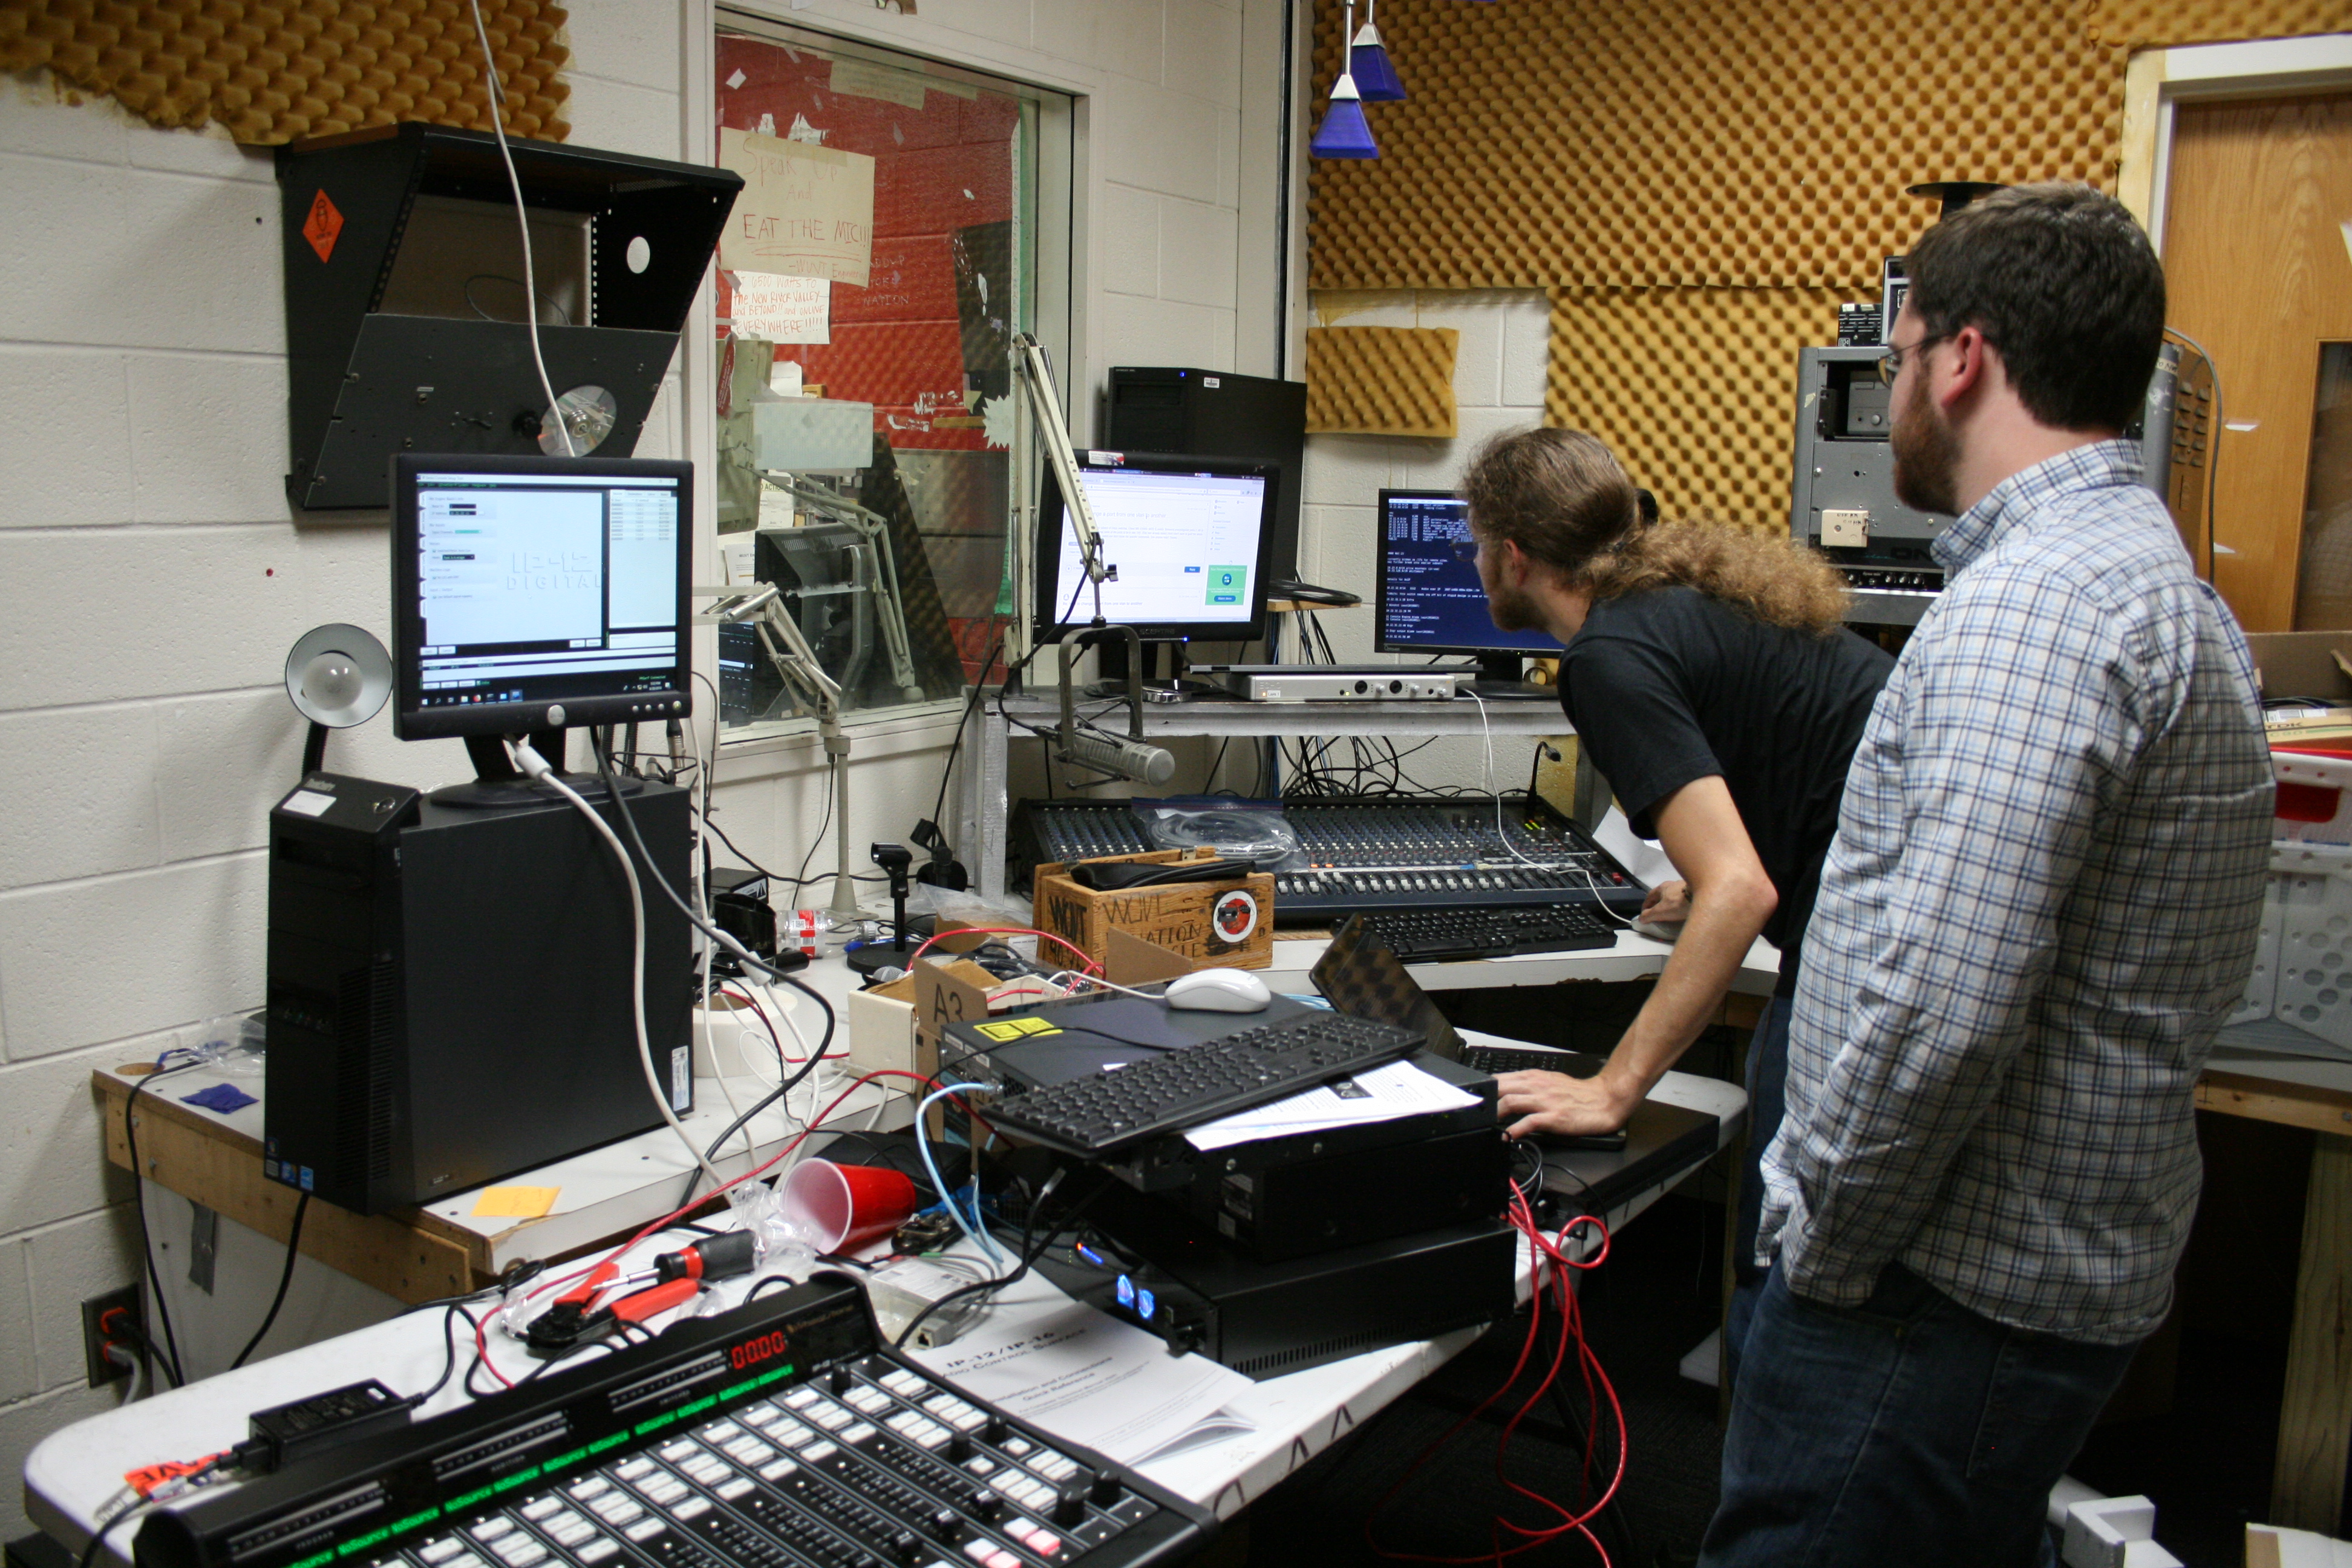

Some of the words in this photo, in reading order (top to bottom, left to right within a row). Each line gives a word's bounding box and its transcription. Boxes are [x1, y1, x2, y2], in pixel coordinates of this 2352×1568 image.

[743, 137, 796, 186] Speak
[813, 146, 837, 181] Up
[786, 181, 812, 201] And
[743, 214, 780, 240] EAT
[788, 218, 825, 240] THE
[752, 276, 771, 287] 6500
[777, 276, 802, 288] Watts
[733, 292, 748, 305] the
[863, 295, 909, 306] NATION
[732, 306, 745, 316] and
[785, 305, 796, 315] and
[800, 305, 825, 315] ONLINE
[506, 574, 601, 591] DIGITAL
[337, 1527, 388, 1556] NoSource
[390, 1506, 440, 1535] NoSource
[443, 1484, 492, 1513] NoSource
